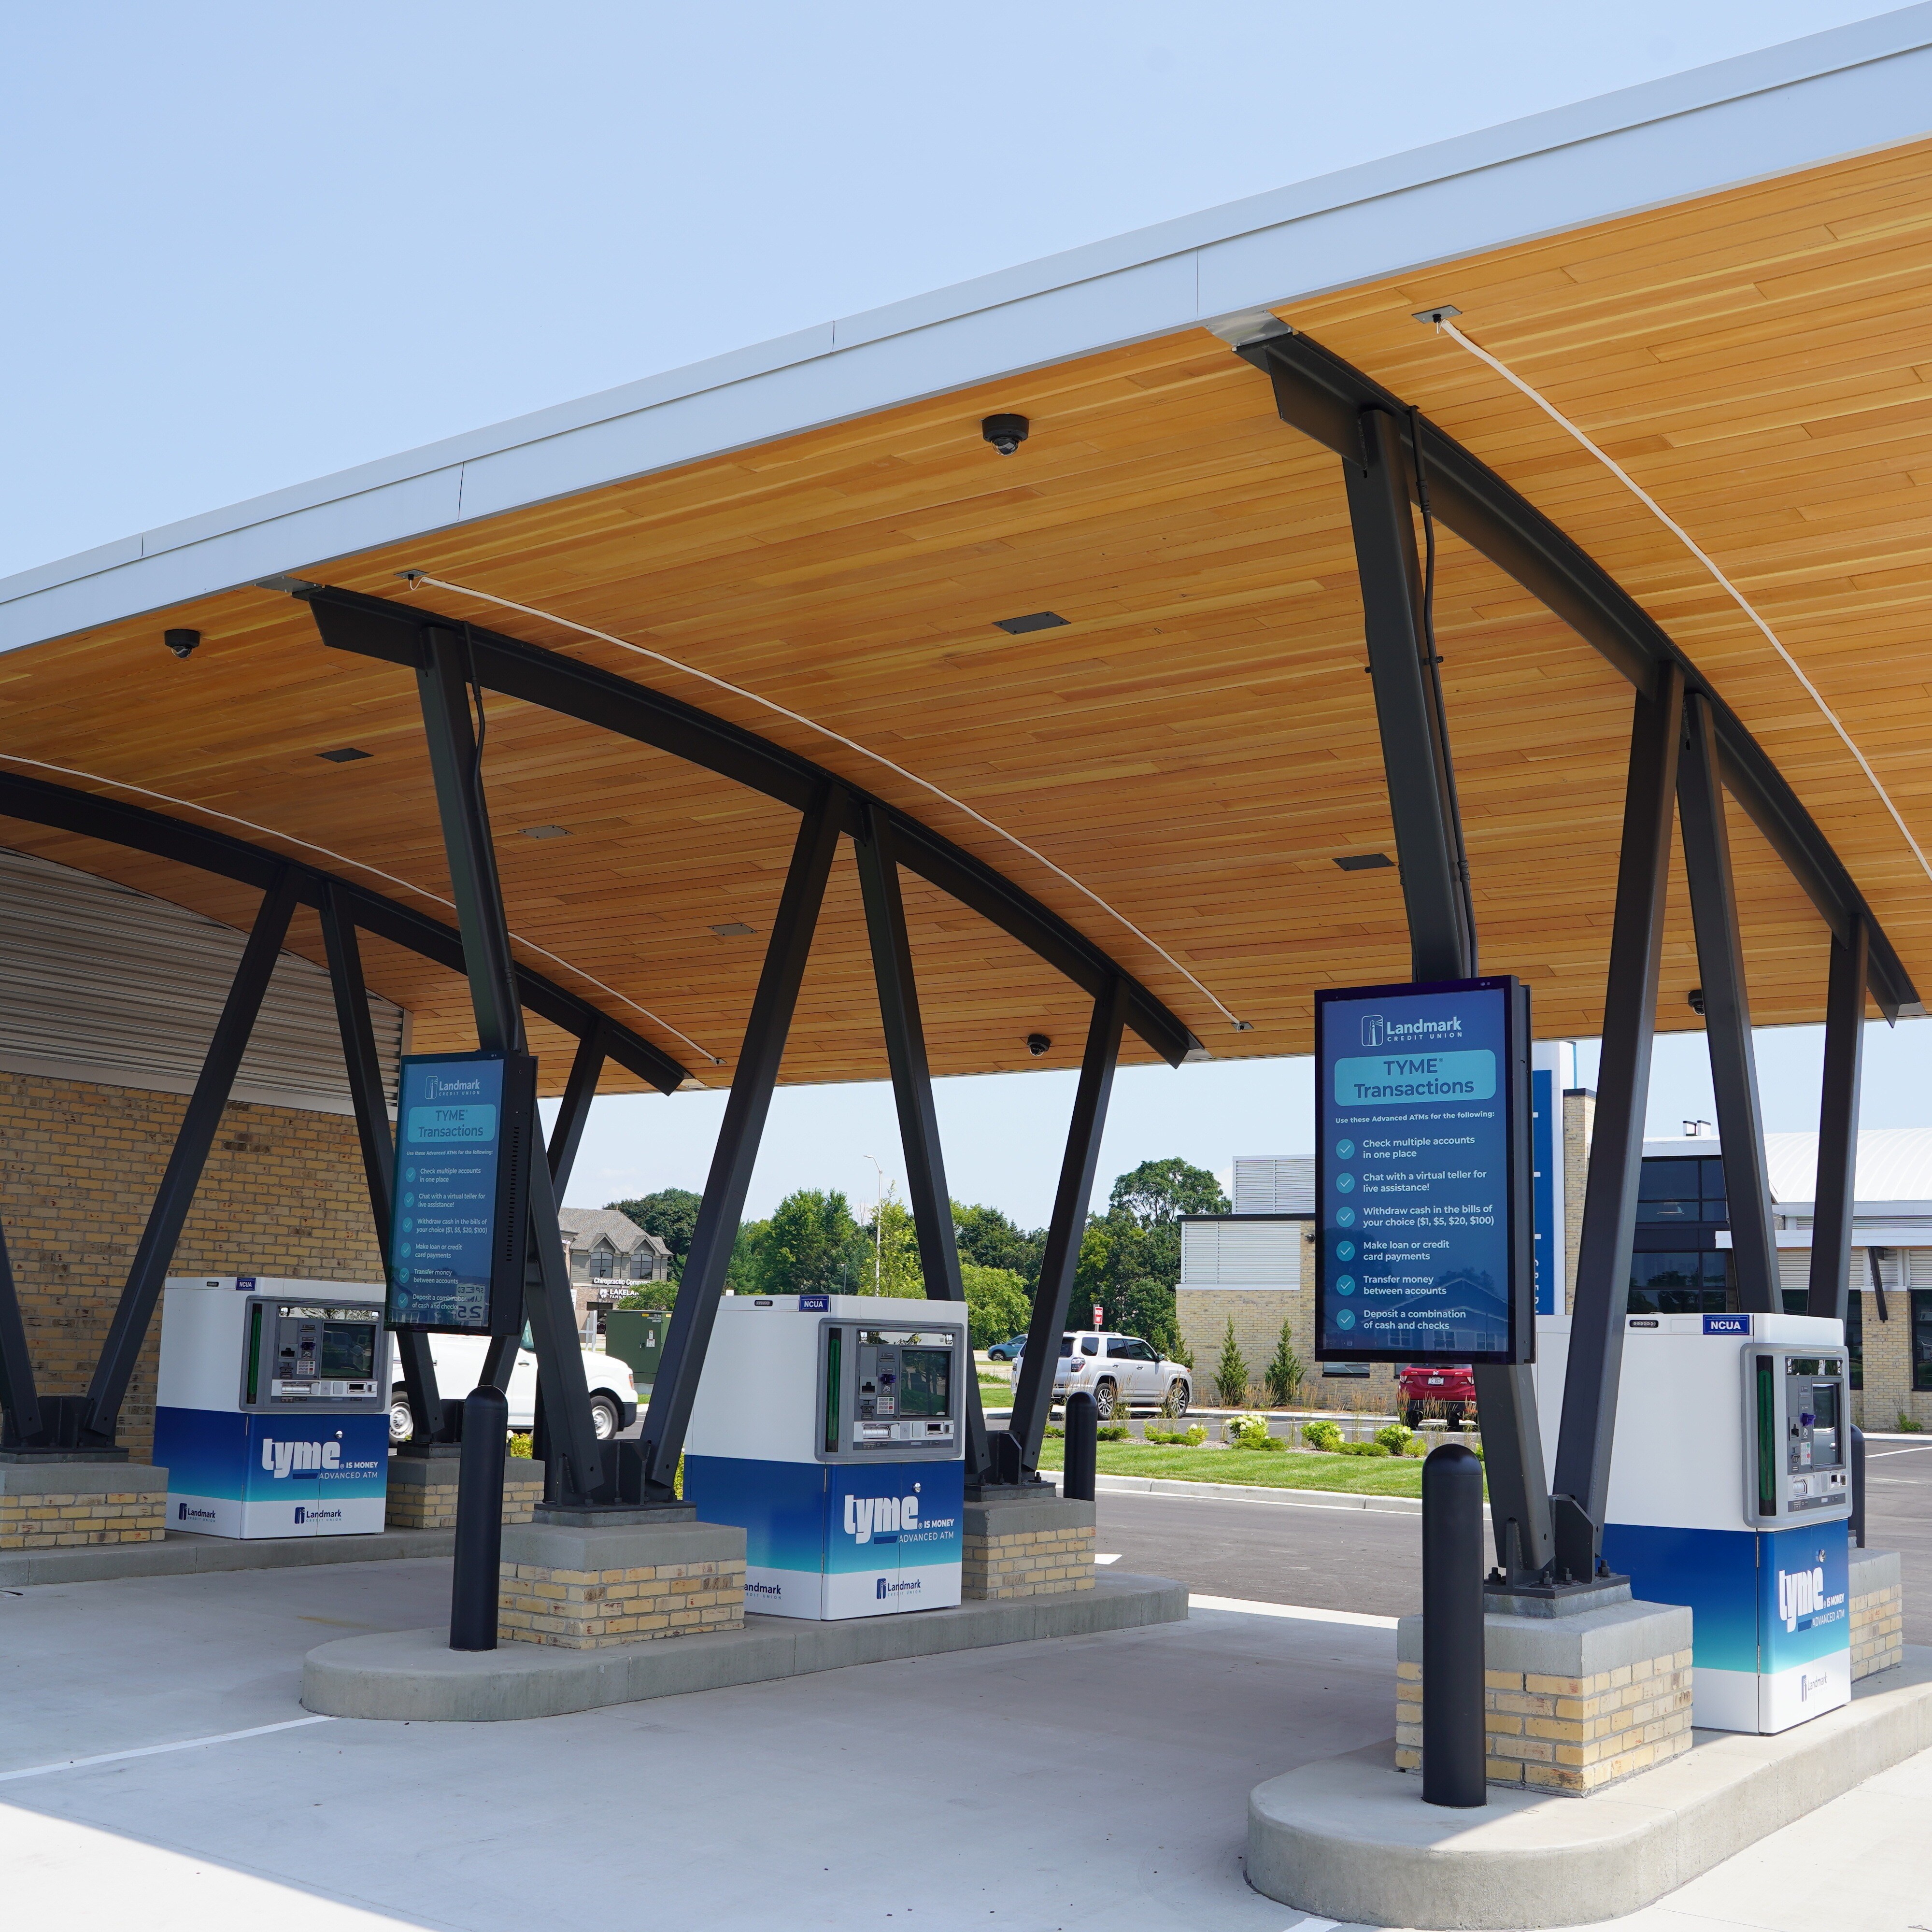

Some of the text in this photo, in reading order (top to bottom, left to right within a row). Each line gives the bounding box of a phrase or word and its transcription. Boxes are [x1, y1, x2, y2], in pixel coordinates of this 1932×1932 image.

[1387, 1016, 1462, 1035] Landmark
[439, 1079, 480, 1091] Landmark
[1354, 1078, 1474, 1098] Transactions
[1458, 1111, 1495, 1120] following:
[418, 1125, 483, 1137] Transactions
[1363, 1140, 1391, 1148] Check
[1393, 1137, 1431, 1147] multiple
[1393, 1150, 1417, 1159] place
[1363, 1173, 1384, 1181] Chat
[1386, 1172, 1406, 1180] with
[1473, 1170, 1487, 1178] for
[1380, 1183, 1430, 1192] assistance!
[1364, 1207, 1407, 1215] Withdraw
[1410, 1206, 1431, 1214] cash
[1483, 1205, 1492, 1213] of
[1363, 1216, 1494, 1228] your choice ($1, $5, $20, $100)
[1364, 1241, 1387, 1250] Make
[1390, 1241, 1408, 1249] loan
[1364, 1252, 1430, 1261] card payments
[1402, 1277, 1434, 1285] money
[1364, 1310, 1398, 1319] Deposit
[1711, 1321, 1741, 1330] NCUA
[188, 1508, 215, 1519] Landmark
[306, 1509, 341, 1519] Landmark
[932, 1519, 954, 1528] MONEY
[899, 1531, 953, 1543] ADVANCED ATM
[744, 1582, 781, 1594] andmark
[888, 1580, 921, 1591] Landmark
[1827, 1597, 1831, 1607] IS
[1831, 1593, 1845, 1606] MONEY
[1812, 1609, 1845, 1627] ADVANCED ATM
[1808, 1673, 1827, 1690] Landmark
